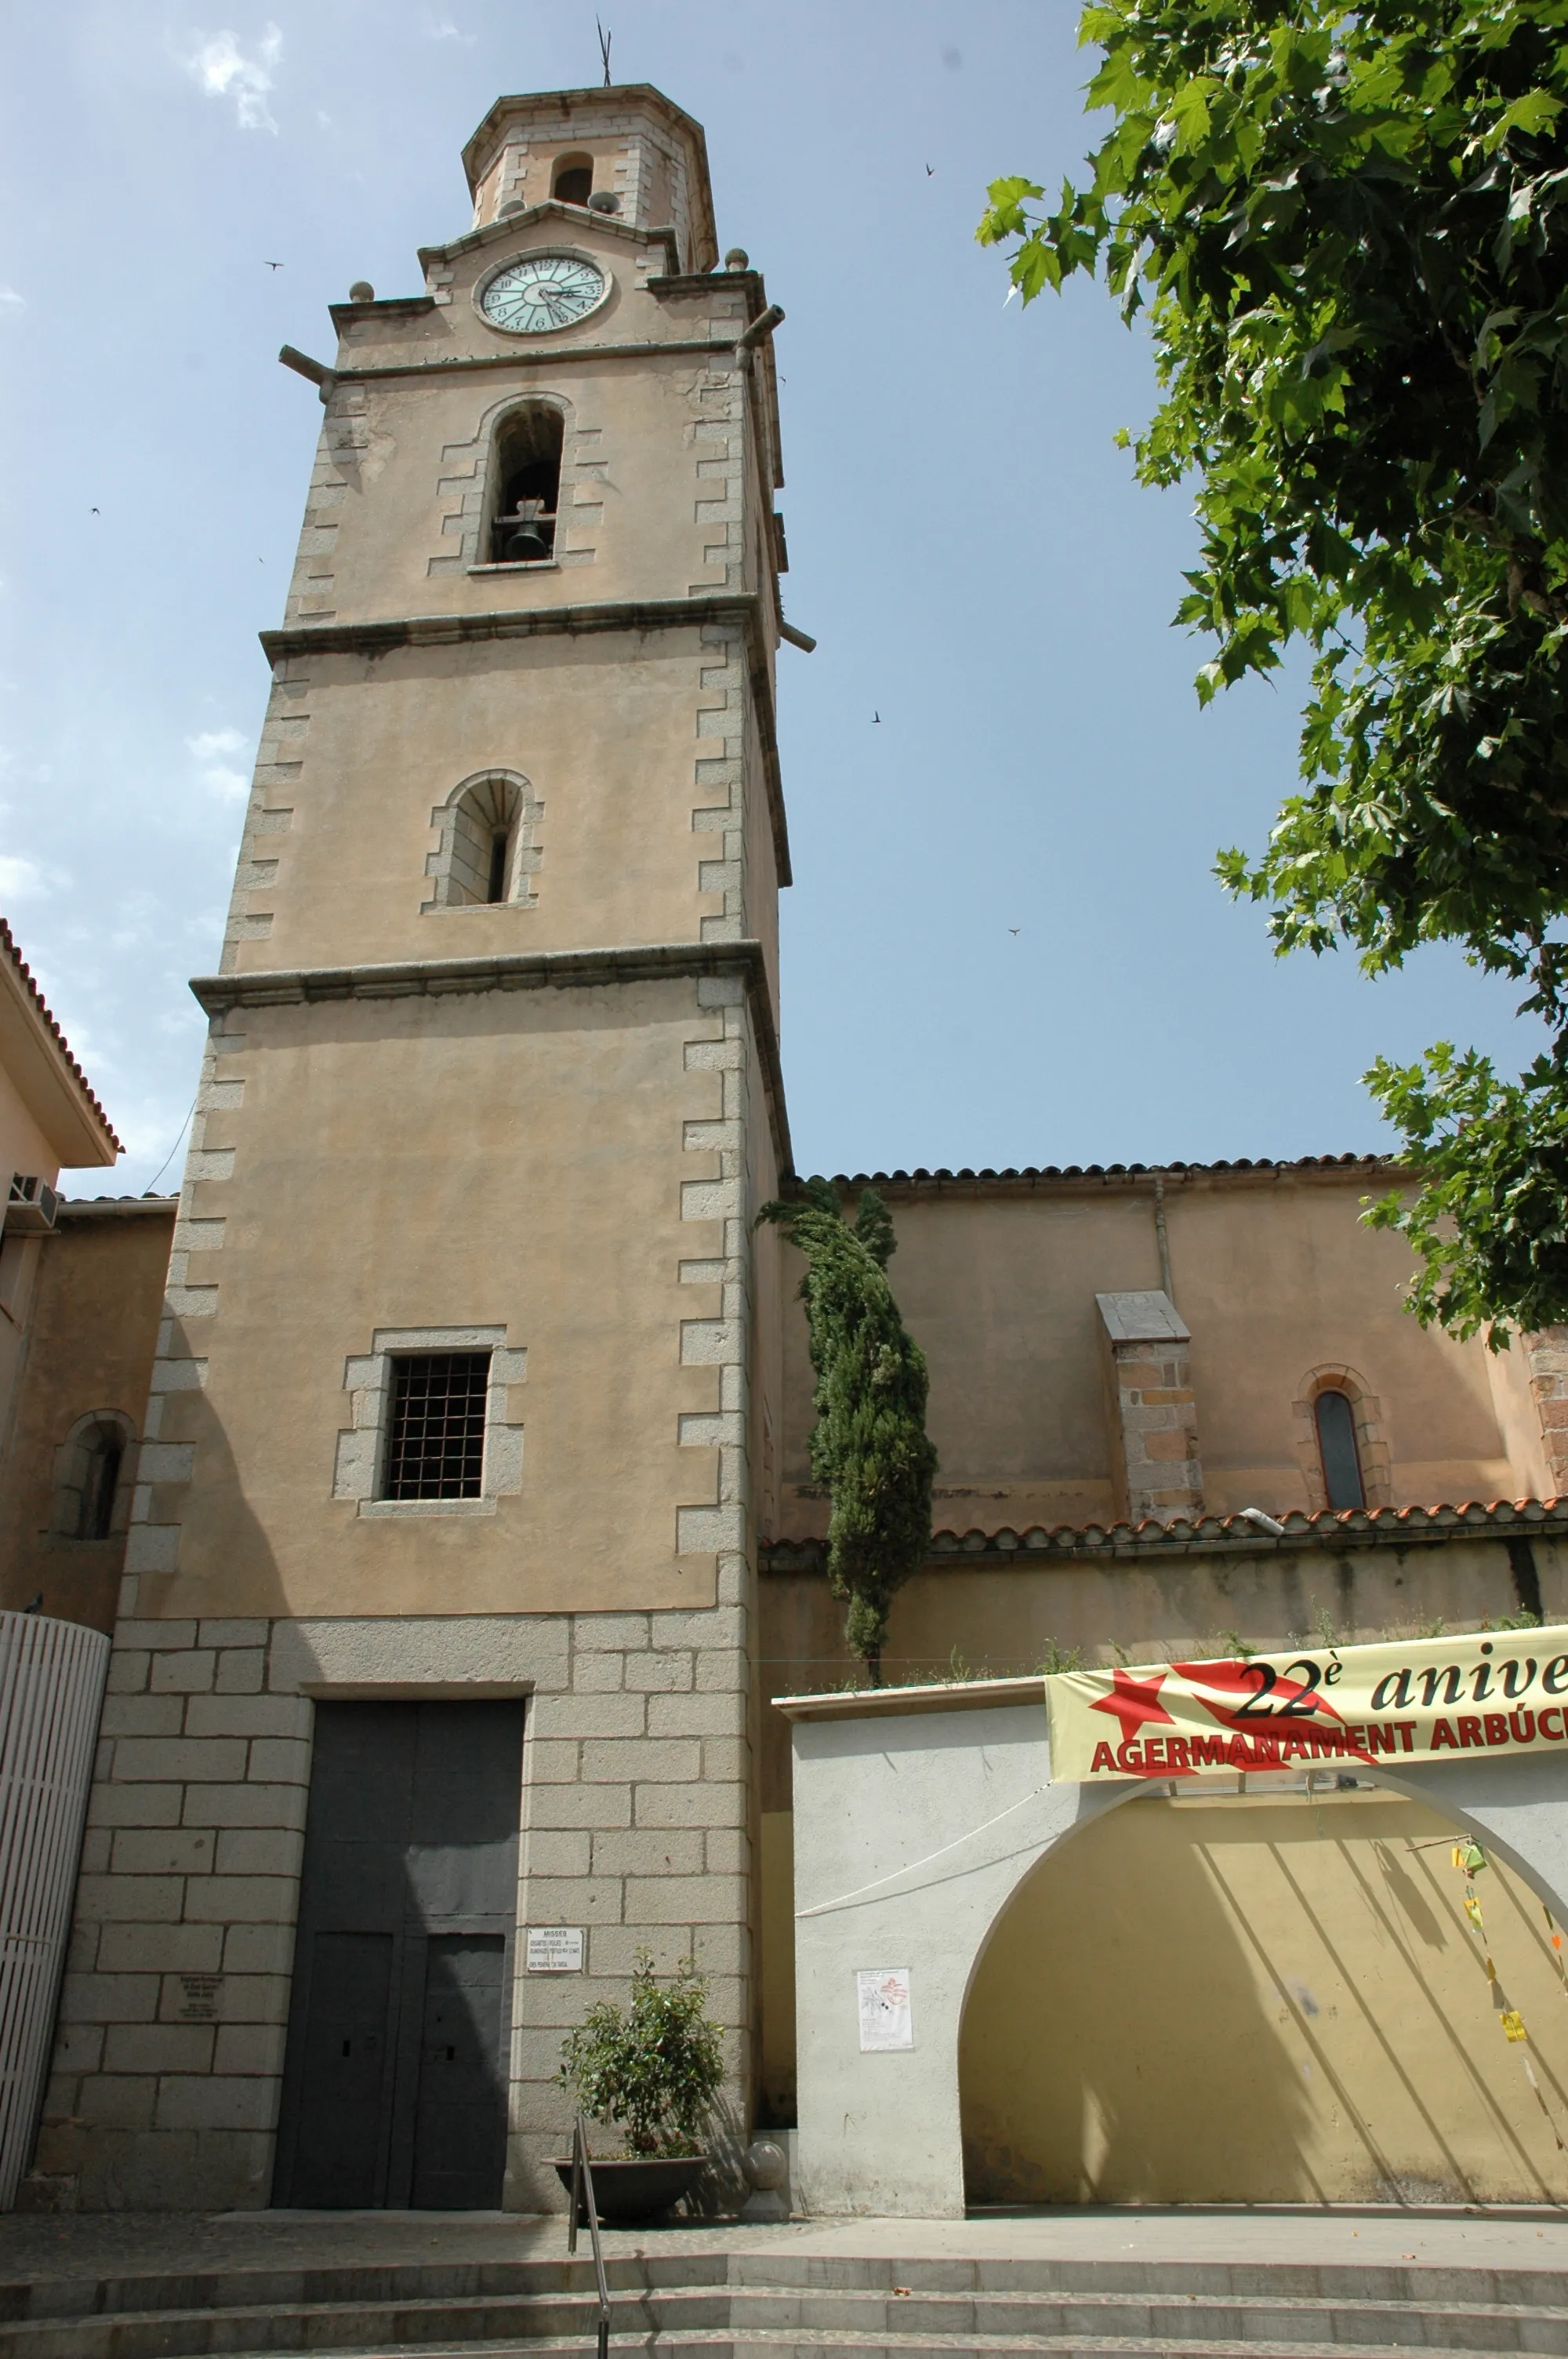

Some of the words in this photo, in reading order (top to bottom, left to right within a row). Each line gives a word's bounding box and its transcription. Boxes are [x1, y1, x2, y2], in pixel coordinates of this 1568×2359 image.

[539, 263, 552, 271] 12
[518, 268, 528, 277] 11
[500, 280, 511, 289] 10
[586, 285, 596, 295] 3
[492, 294, 501, 304] 9
[576, 300, 586, 309] 4
[498, 307, 507, 317] 8
[514, 316, 525, 327] 7
[535, 318, 545, 328] 6
[1230, 1649, 1343, 1719] 22è
[1091, 1720, 1417, 1772] AGERMANAMENT
